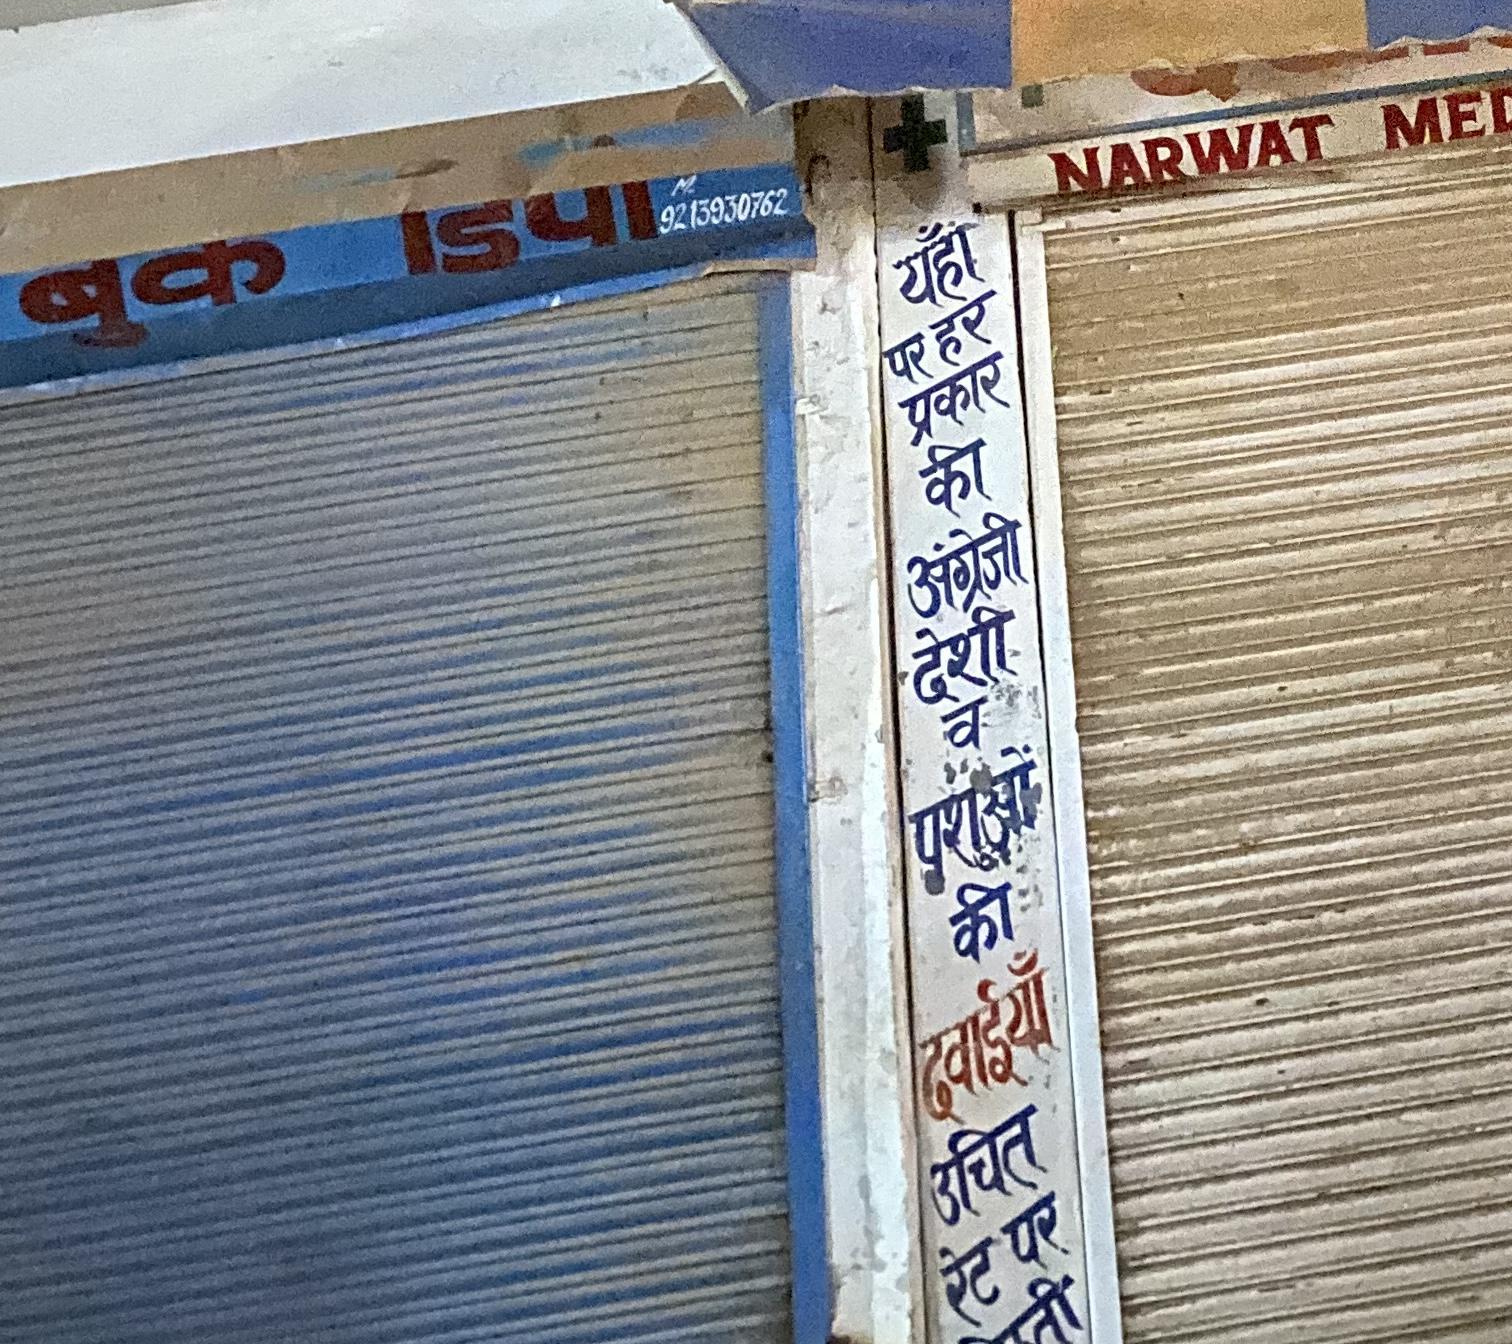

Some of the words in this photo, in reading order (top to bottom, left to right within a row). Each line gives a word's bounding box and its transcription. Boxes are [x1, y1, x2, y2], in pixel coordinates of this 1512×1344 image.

[1047, 113, 1335, 196] NARWAT
[898, 350, 1010, 446] प्रकार
[918, 438, 992, 518] की
[907, 512, 1029, 618] अंग्रेजी
[912, 606, 1018, 704] देशी
[949, 882, 1015, 963] की
[931, 1104, 1047, 1226] उचित
[1000, 1191, 1070, 1269] पर
